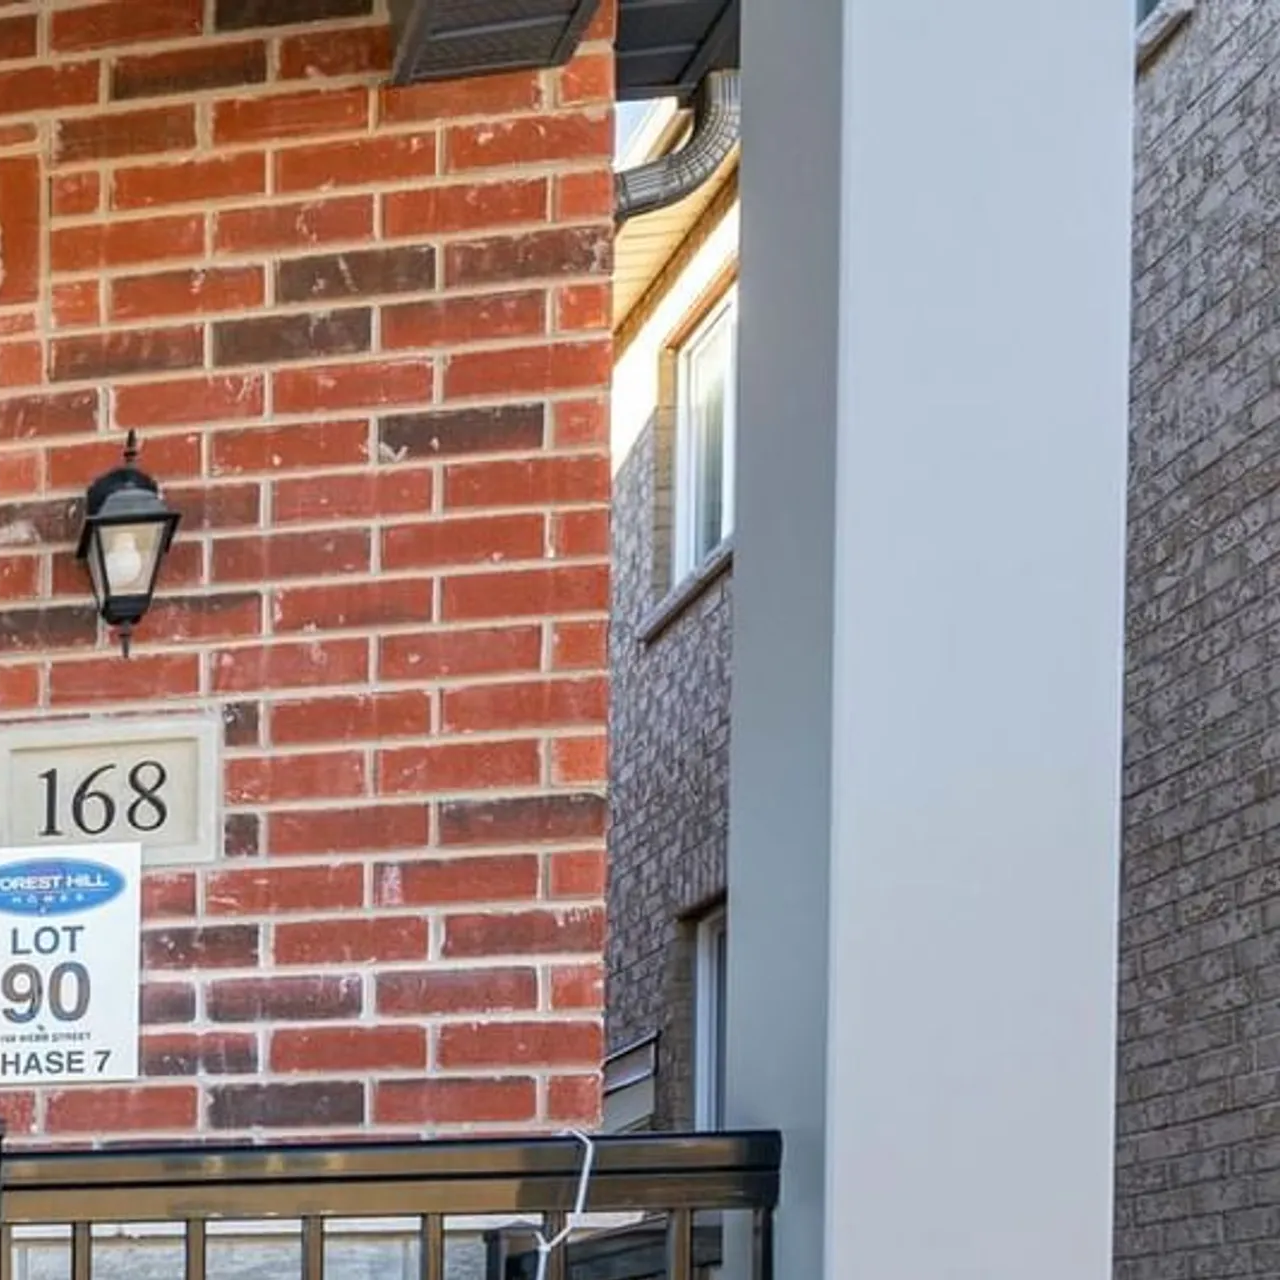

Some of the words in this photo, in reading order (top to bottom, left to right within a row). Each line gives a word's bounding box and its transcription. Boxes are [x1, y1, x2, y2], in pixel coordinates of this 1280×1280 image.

[38, 760, 168, 837] 168
[66, 872, 110, 889] HILL
[11, 925, 86, 955] LOT
[1, 961, 91, 1024] 90
[94, 1049, 112, 1073] 7
